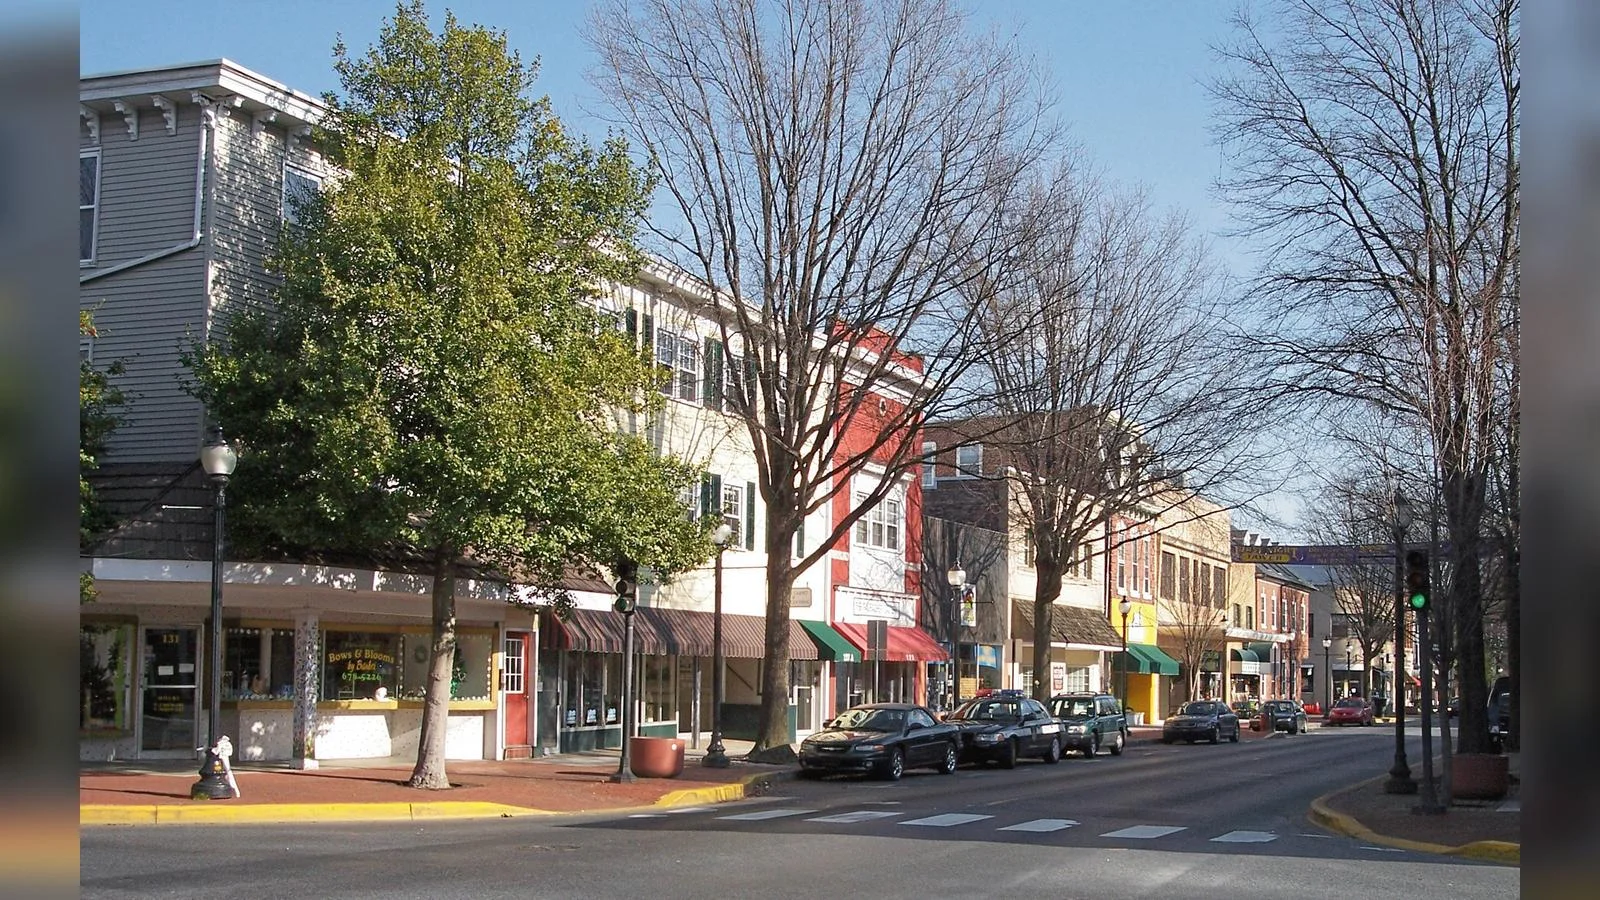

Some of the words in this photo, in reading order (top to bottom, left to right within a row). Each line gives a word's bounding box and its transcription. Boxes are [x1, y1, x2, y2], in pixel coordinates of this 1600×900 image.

[162, 634, 179, 644] 131
[328, 651, 353, 663] Bows
[354, 649, 362, 659] &
[364, 649, 395, 664] Blooms
[347, 660, 354, 672] by
